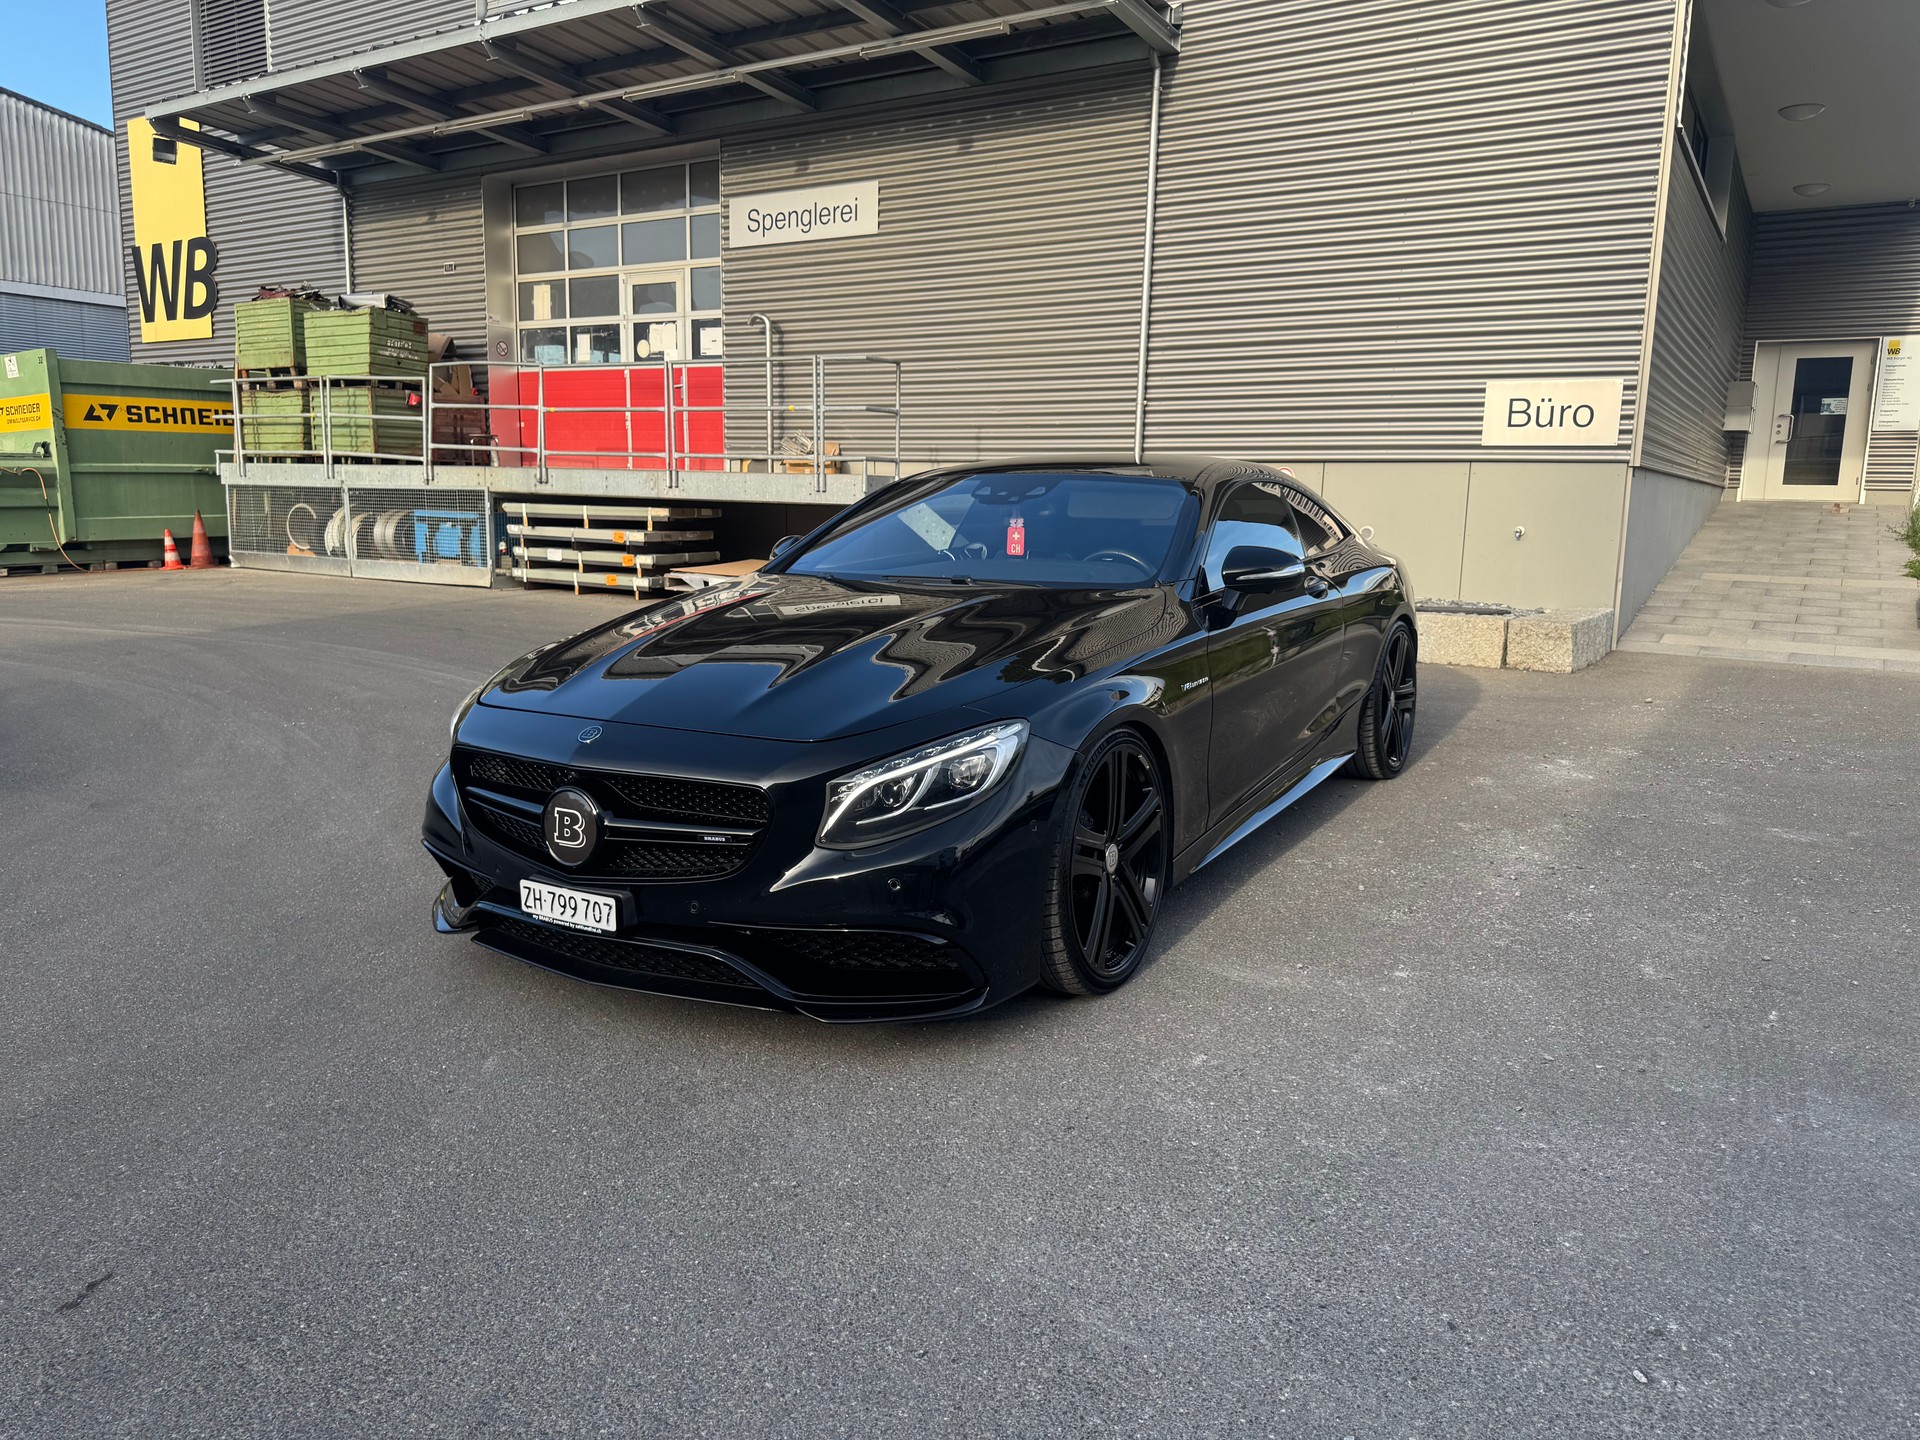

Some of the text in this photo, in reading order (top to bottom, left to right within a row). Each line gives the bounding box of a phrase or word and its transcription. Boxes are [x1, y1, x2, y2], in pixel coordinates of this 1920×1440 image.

[747, 197, 858, 238] Spenglerei
[131, 236, 218, 323] WB
[1887, 347, 1901, 355] WB
[5, 402, 41, 416] SCHNEIDER
[126, 404, 236, 427] SCHNEID
[1507, 398, 1595, 428] Büro
[1011, 543, 1021, 554] CH
[554, 806, 587, 849] B
